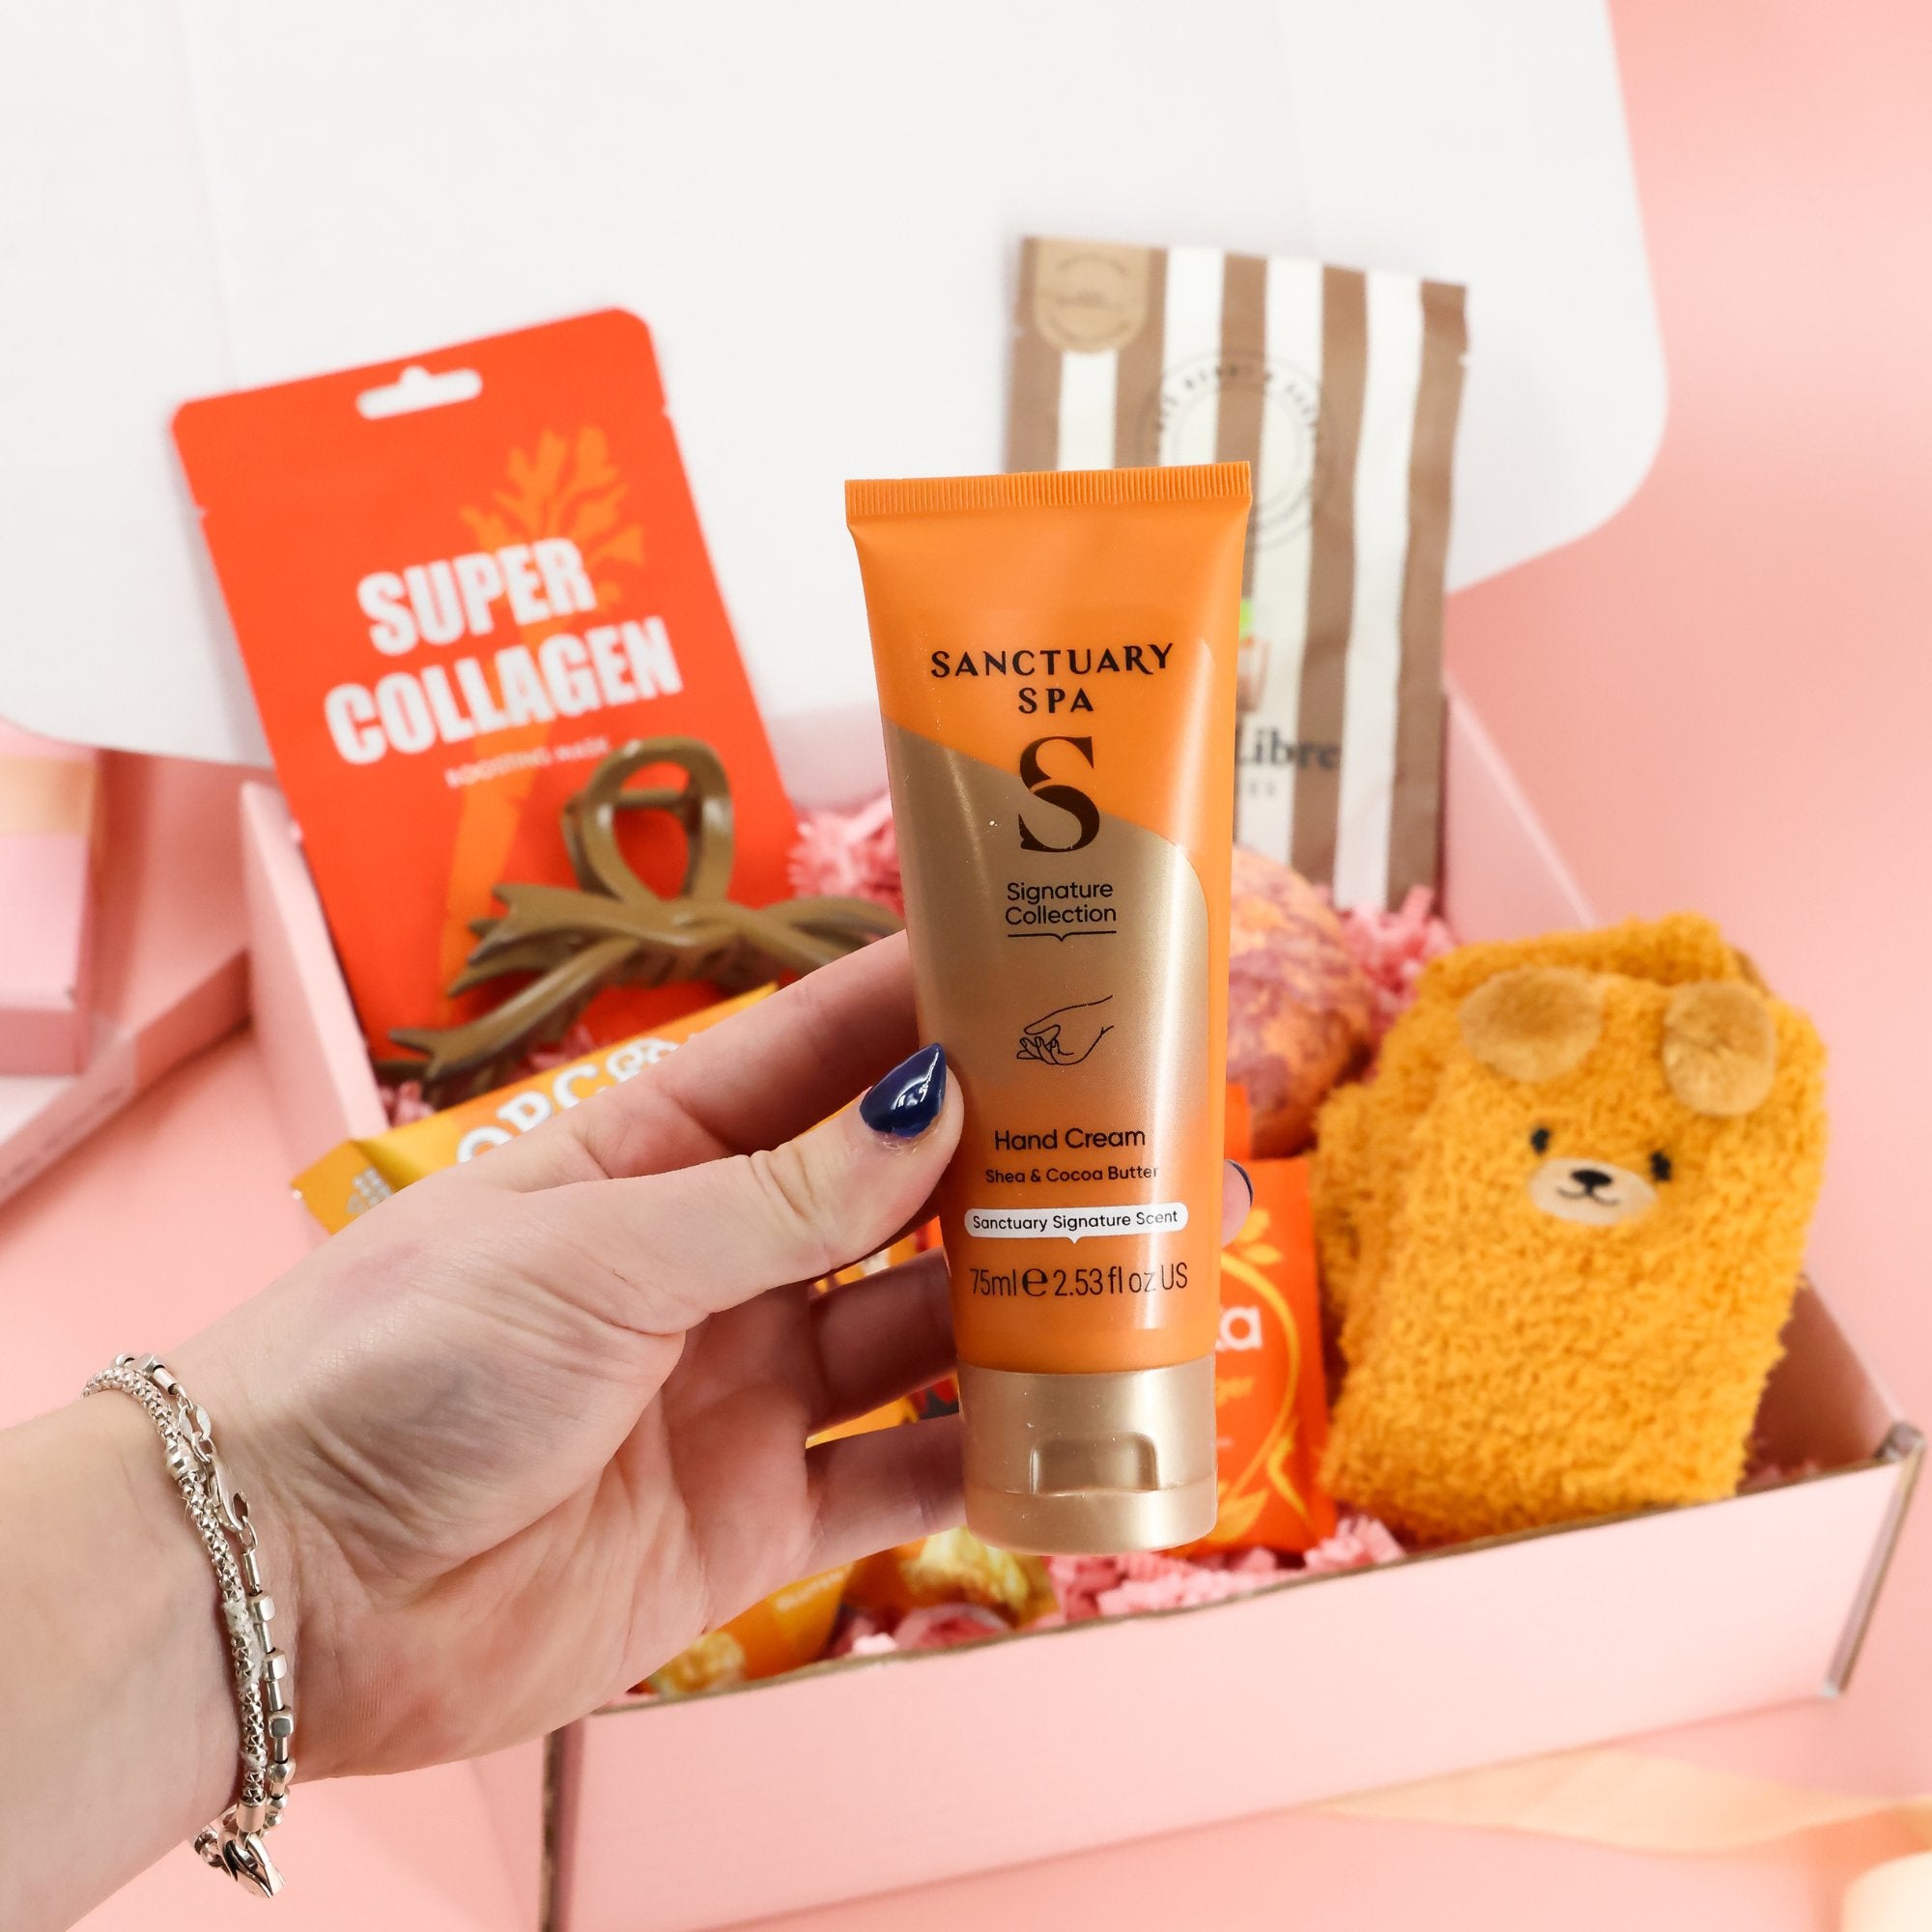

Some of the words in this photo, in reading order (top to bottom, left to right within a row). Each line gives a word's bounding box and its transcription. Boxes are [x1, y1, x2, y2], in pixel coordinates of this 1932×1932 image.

[356, 537, 596, 655] SUPER
[930, 642, 1174, 678] SANCTUARY
[324, 615, 683, 764] COLLAGEN
[1017, 687, 1094, 714] SPA
[1018, 735, 1100, 853] S
[1007, 882, 1113, 905] Signature
[1005, 905, 1117, 925] Collection
[994, 1129, 1057, 1151] Hand
[1065, 1127, 1146, 1150] Cream
[985, 1168, 1025, 1184] Shea
[1030, 1168, 1041, 1182] &
[1046, 1167, 1103, 1182] Cocoa
[1108, 1165, 1159, 1180] Butter
[973, 1214, 1048, 1233] Sanctuary
[1052, 1211, 1131, 1232] Signature
[1136, 1209, 1178, 1226] Scent
[970, 1267, 1017, 1296] 75ml
[1053, 1267, 1103, 1296] 2.53
[1108, 1265, 1123, 1294] fl
[1128, 1270, 1156, 1293] oz
[1161, 1262, 1188, 1291] US
